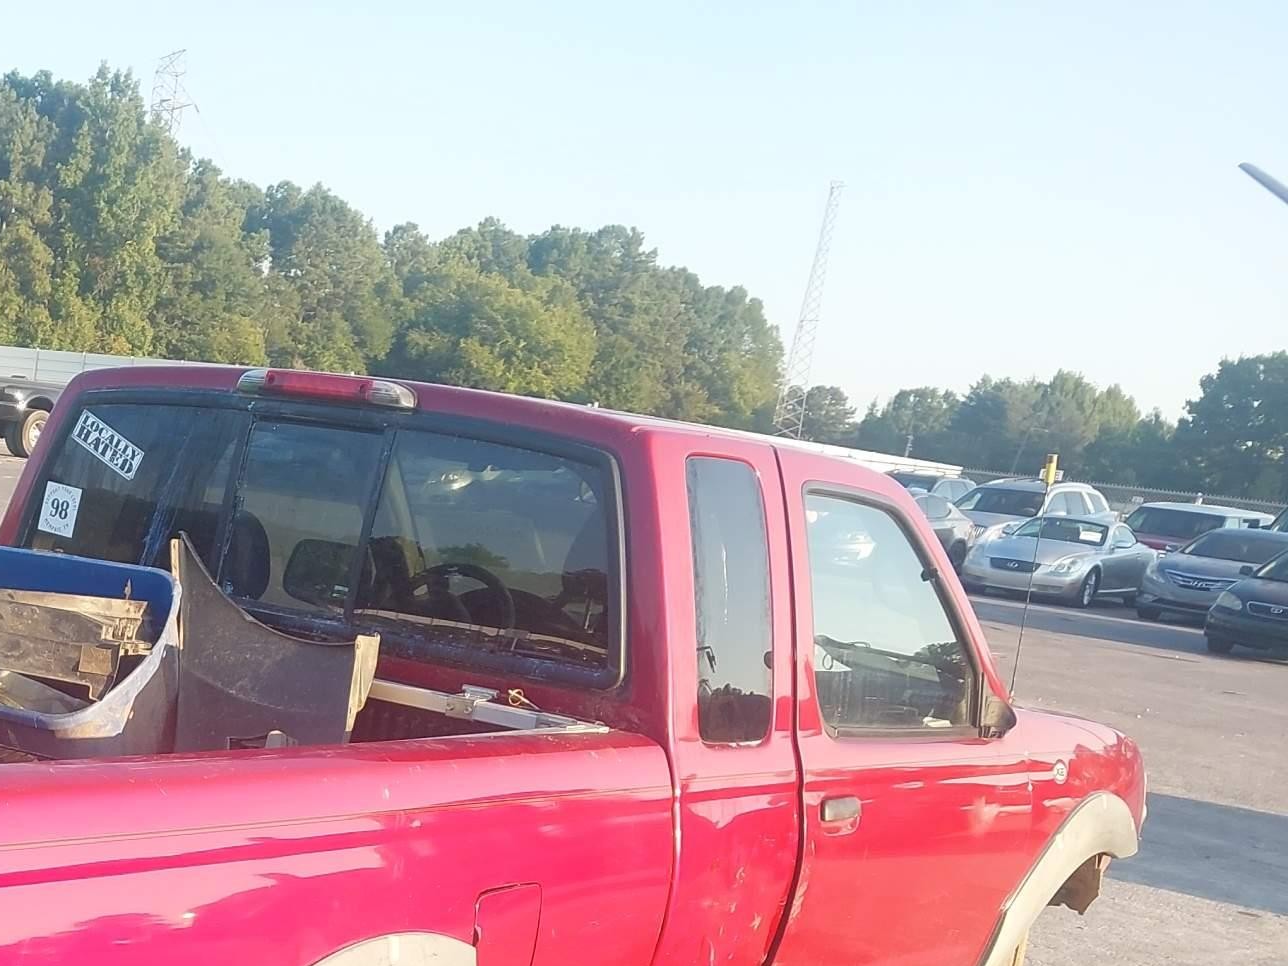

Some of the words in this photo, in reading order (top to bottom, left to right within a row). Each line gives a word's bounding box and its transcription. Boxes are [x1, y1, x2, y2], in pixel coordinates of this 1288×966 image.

[76, 425, 134, 474] HATED
[81, 415, 140, 461] LOCALLY
[50, 498, 69, 519] 98
